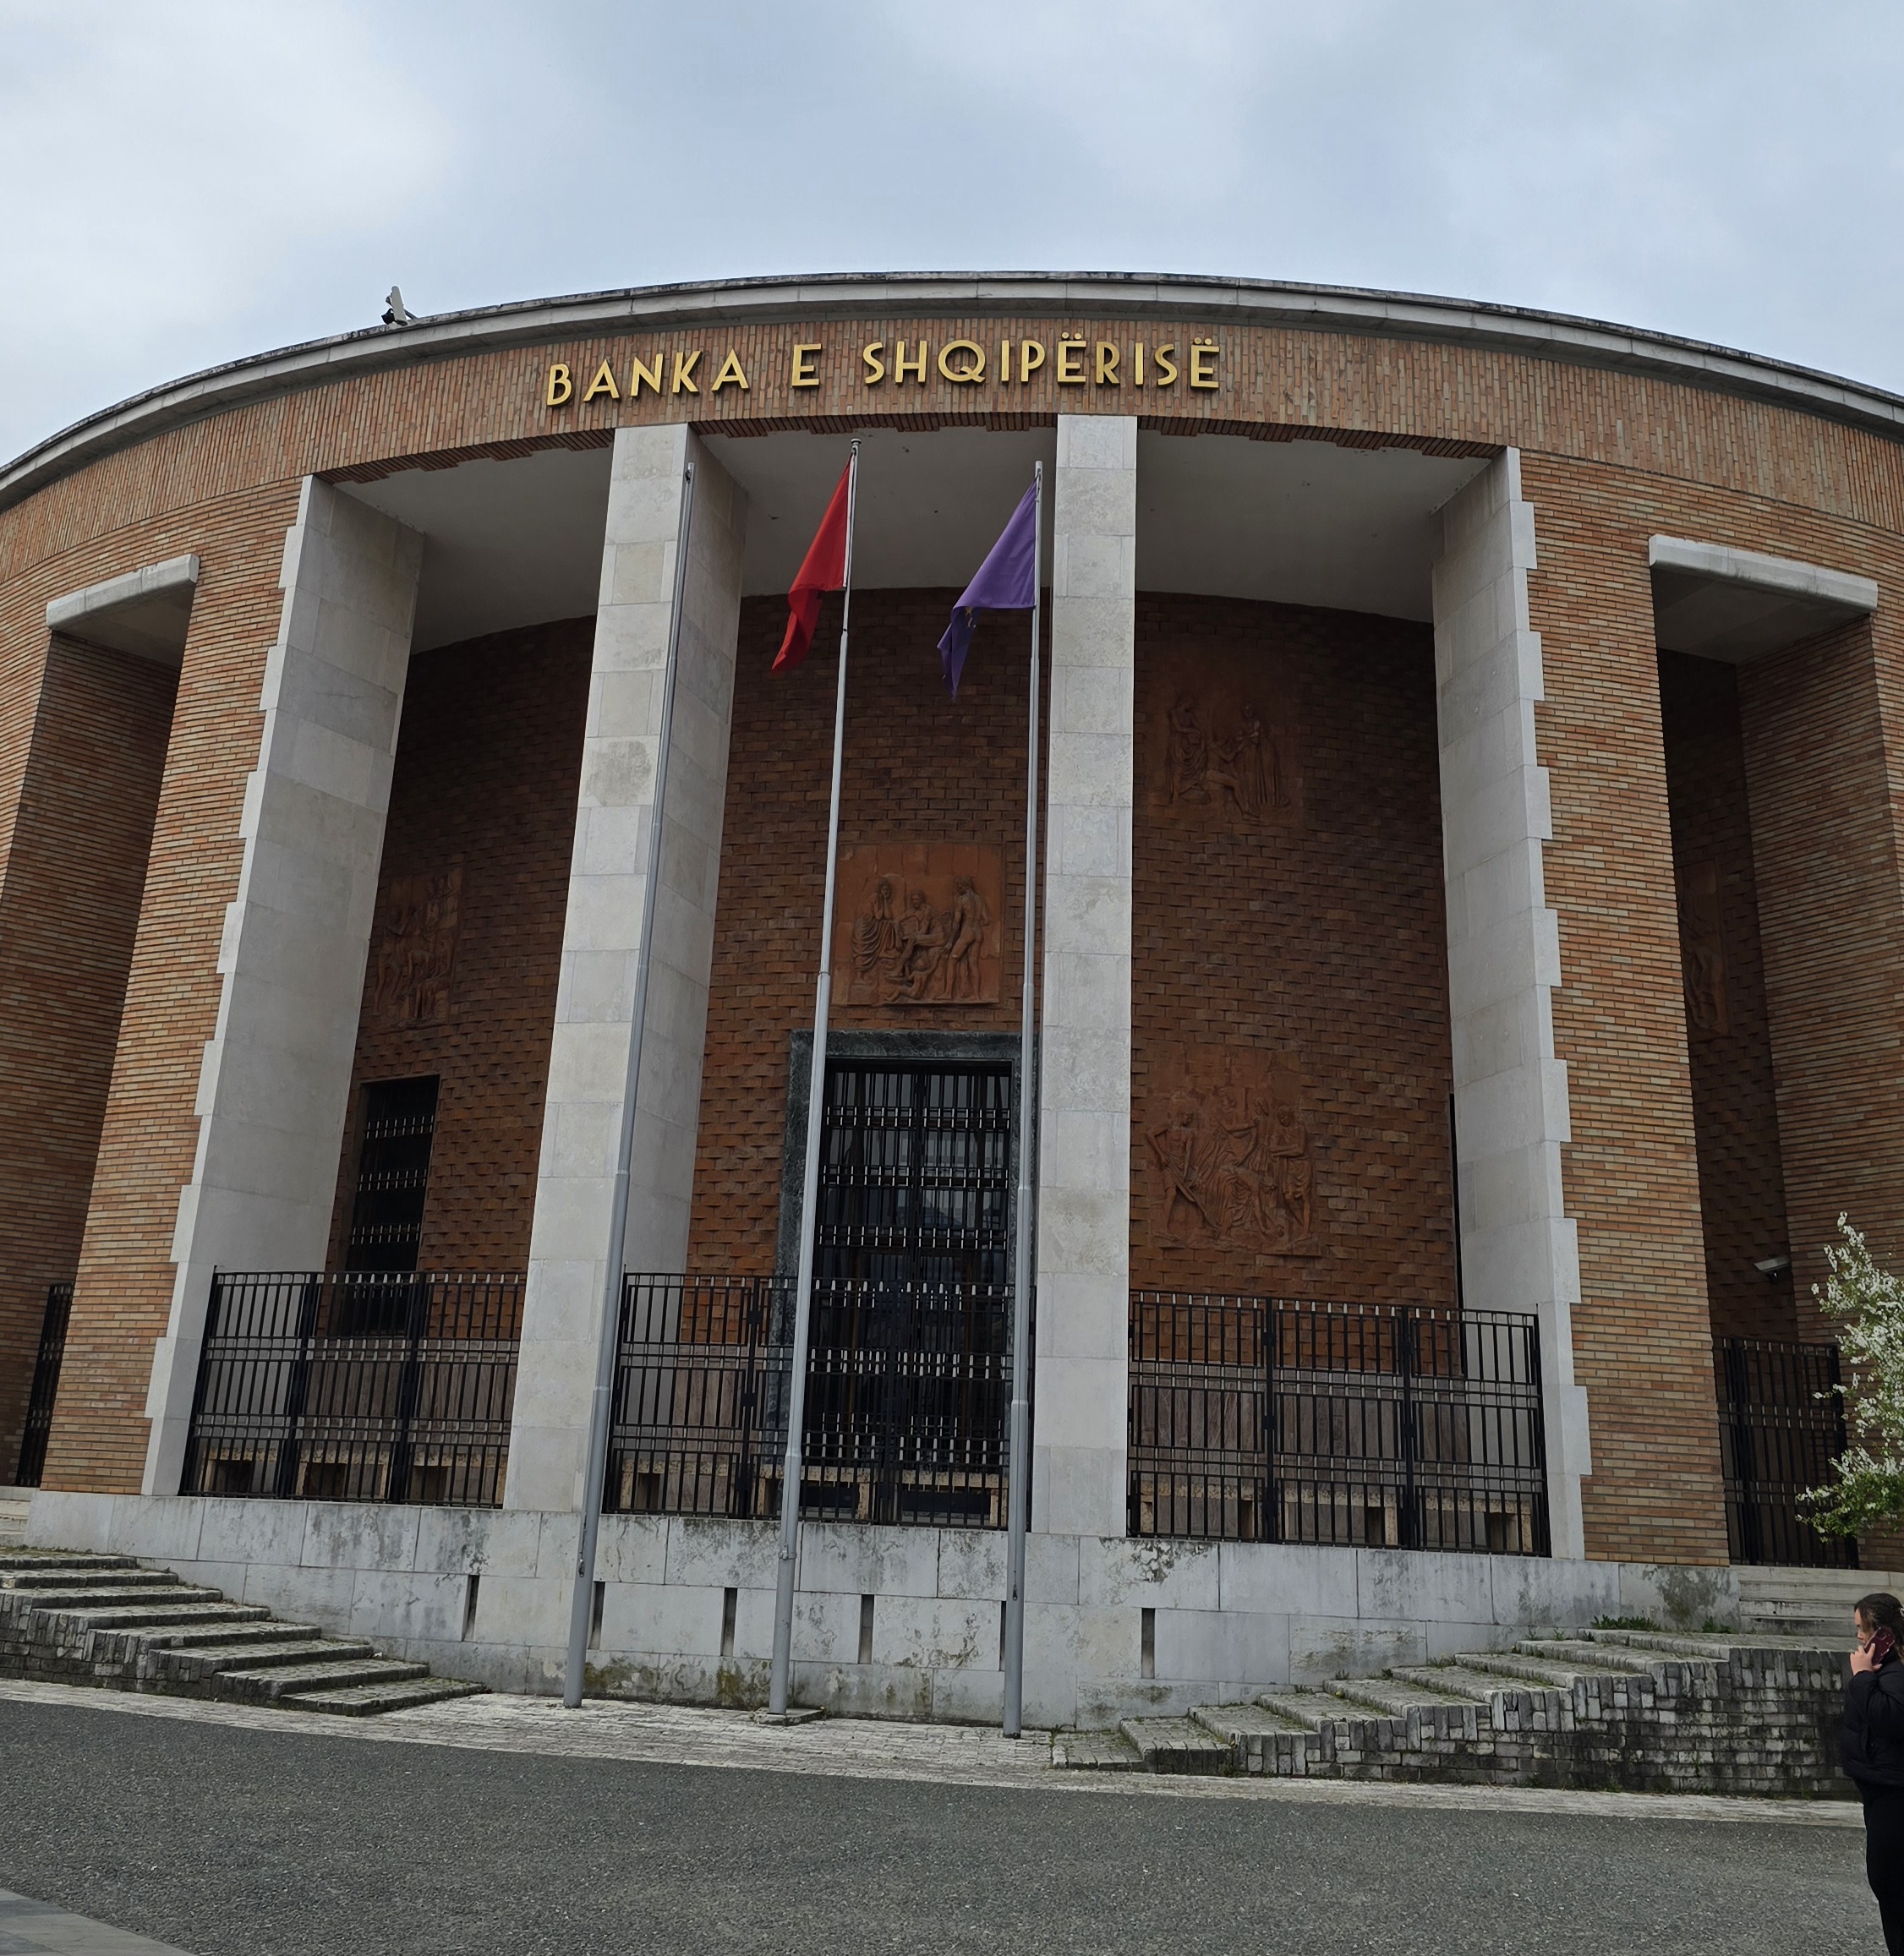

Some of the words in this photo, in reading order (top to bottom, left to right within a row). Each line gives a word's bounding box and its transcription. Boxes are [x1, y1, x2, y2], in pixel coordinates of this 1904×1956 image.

[546, 349, 750, 406] BANKA
[791, 342, 822, 388] E
[862, 331, 1221, 389] SHQIPËRISË
